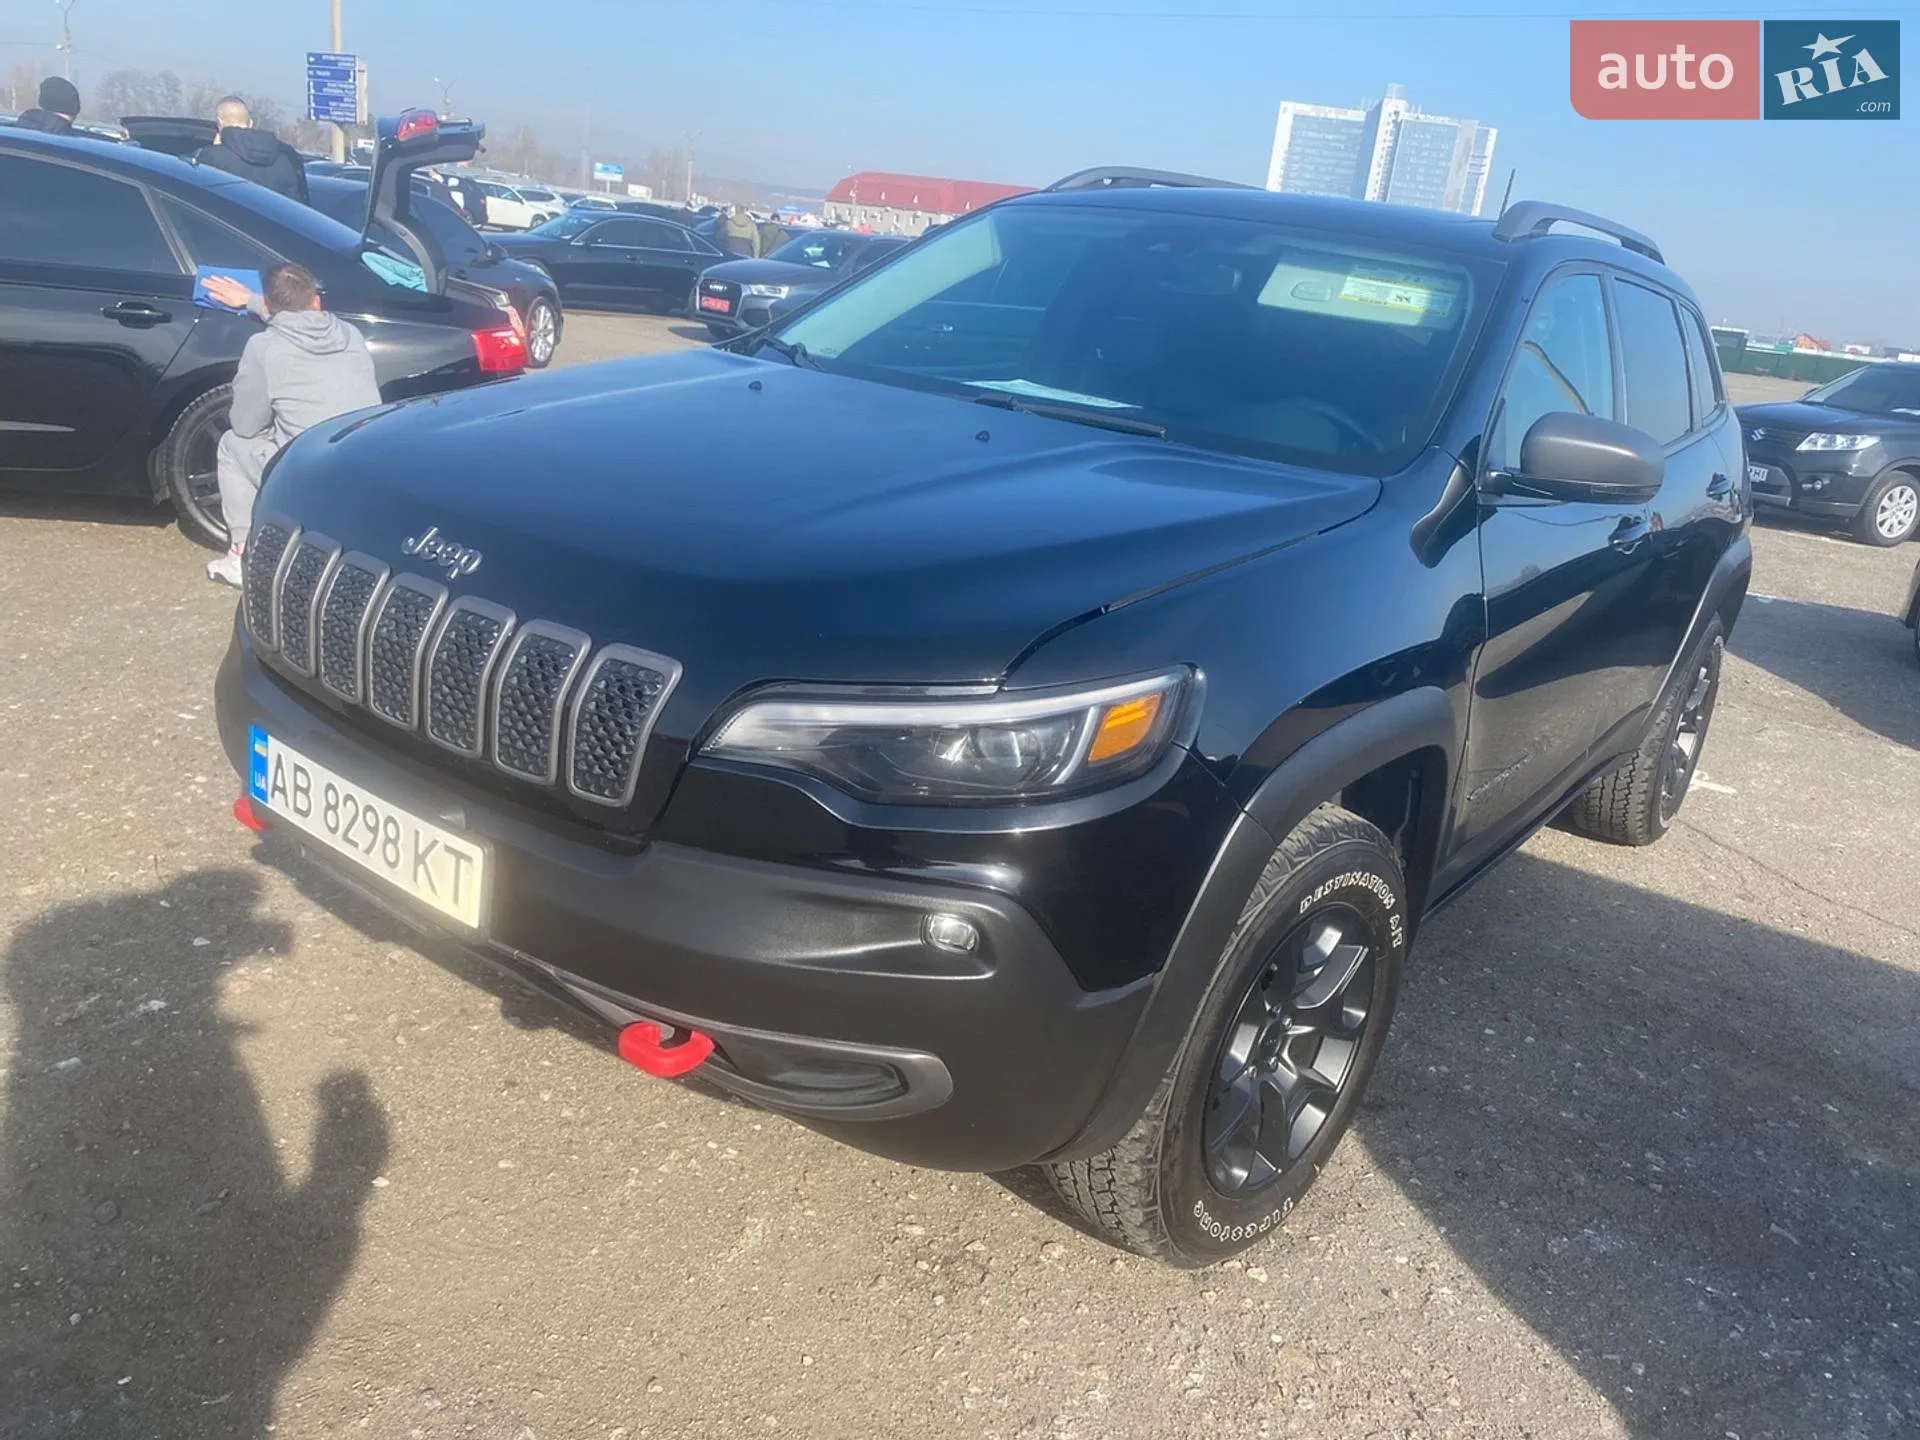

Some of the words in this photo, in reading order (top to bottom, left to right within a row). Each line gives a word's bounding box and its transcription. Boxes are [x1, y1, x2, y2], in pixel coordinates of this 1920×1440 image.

[402, 525, 483, 580] Jeep
[254, 771, 268, 791] UA
[270, 752, 312, 819] AB
[323, 782, 401, 870] 8298
[413, 828, 474, 909] KT
